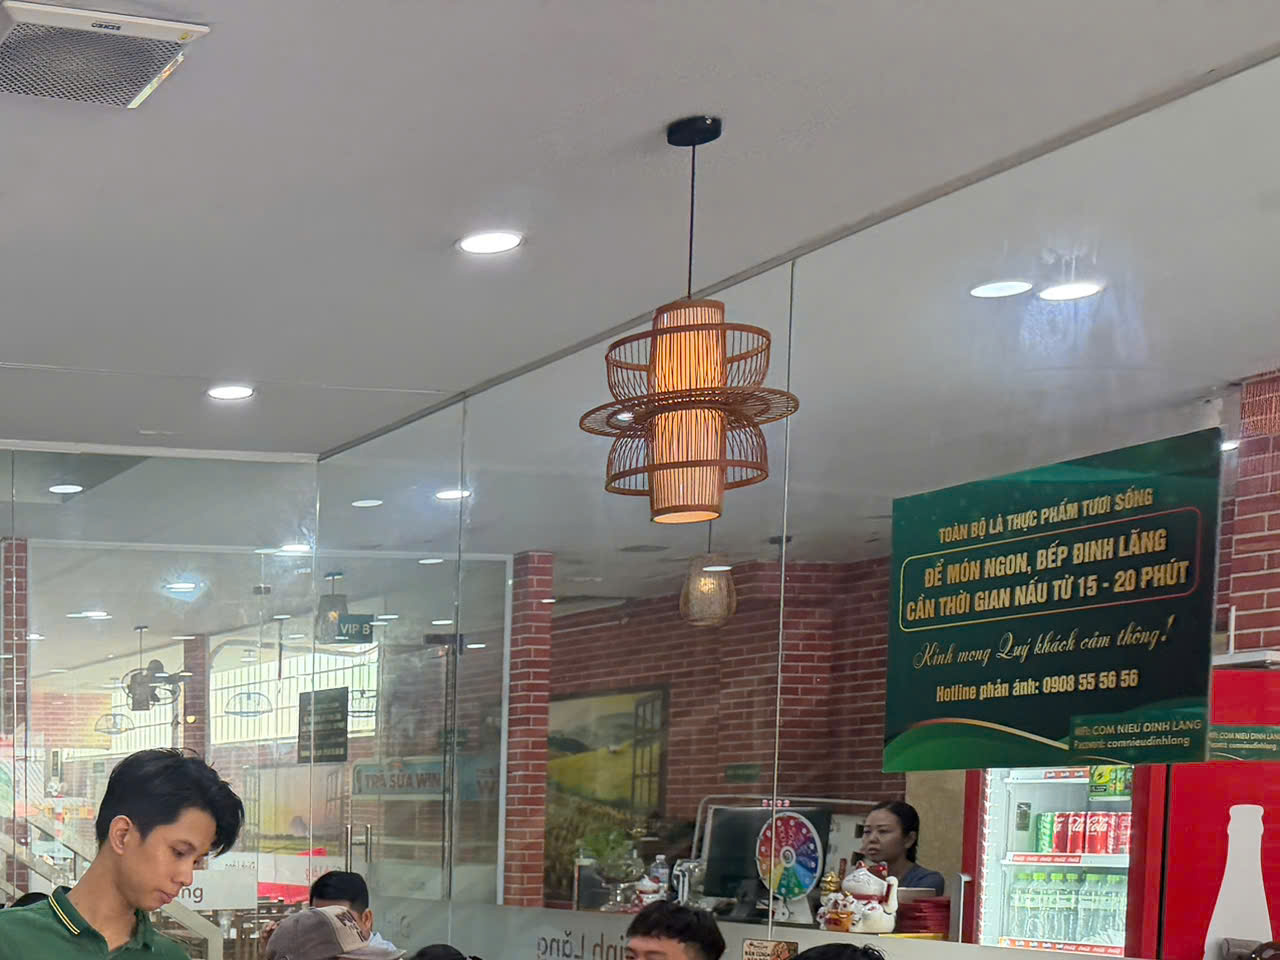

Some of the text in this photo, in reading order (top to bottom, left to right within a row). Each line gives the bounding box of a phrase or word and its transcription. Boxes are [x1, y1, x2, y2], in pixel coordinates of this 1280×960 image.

[938, 522, 968, 544] TOÀN
[970, 517, 986, 540] BỘ
[989, 513, 1004, 534] LÀ
[1007, 509, 1037, 532] THỰC
[924, 558, 944, 588] ĐỂ
[947, 557, 980, 585] MÓN
[984, 552, 1031, 580] NGON,
[1036, 540, 1069, 571] BẾP
[1118, 527, 1168, 558] LĂNG
[906, 592, 936, 621] CẦN
[939, 589, 971, 616] THỜI
[974, 590, 1011, 613] GIAN
[1014, 575, 1048, 606] NẤU
[1052, 574, 1074, 600] TỪ
[1078, 575, 1097, 598] 15
[1113, 570, 1136, 592] 20
[1141, 558, 1190, 589] PHÚT
[957, 647, 992, 667] mong
[995, 631, 1032, 663] Quý
[1033, 627, 1076, 655] khách
[936, 683, 976, 703] Hotline
[1012, 677, 1039, 697] ánh:
[1042, 674, 1075, 694] 0908
[1078, 673, 1095, 691] 55
[1098, 671, 1117, 689] 56
[1119, 669, 1139, 687] 56
[1143, 721, 1170, 733] DINH
[1172, 720, 1202, 730] LANG
